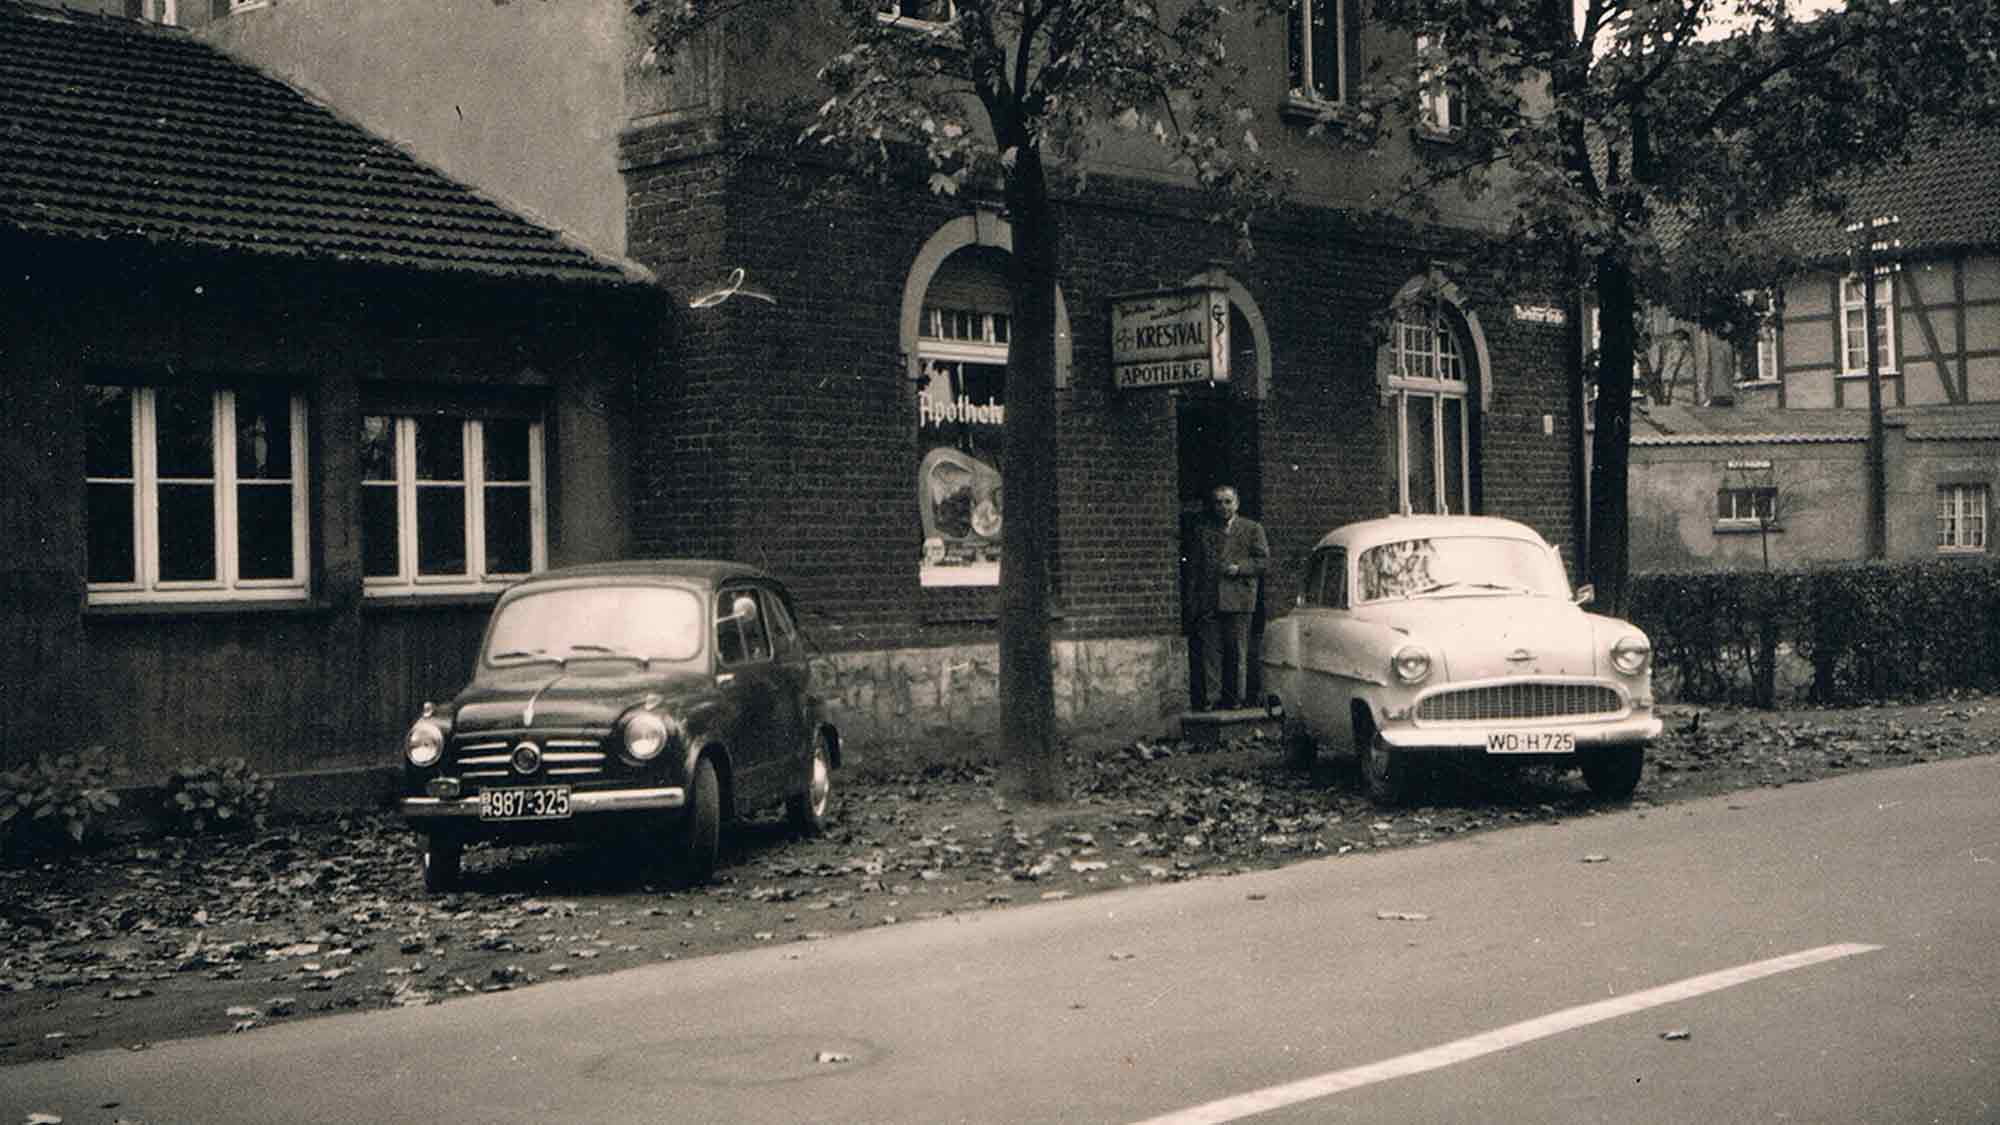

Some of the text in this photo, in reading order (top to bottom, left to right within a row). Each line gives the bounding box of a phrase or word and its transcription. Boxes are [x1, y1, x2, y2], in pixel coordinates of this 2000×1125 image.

[1120, 362, 1203, 386] APOTHEKE
[1543, 733, 1573, 750] 725
[492, 789, 569, 817] 987-325
